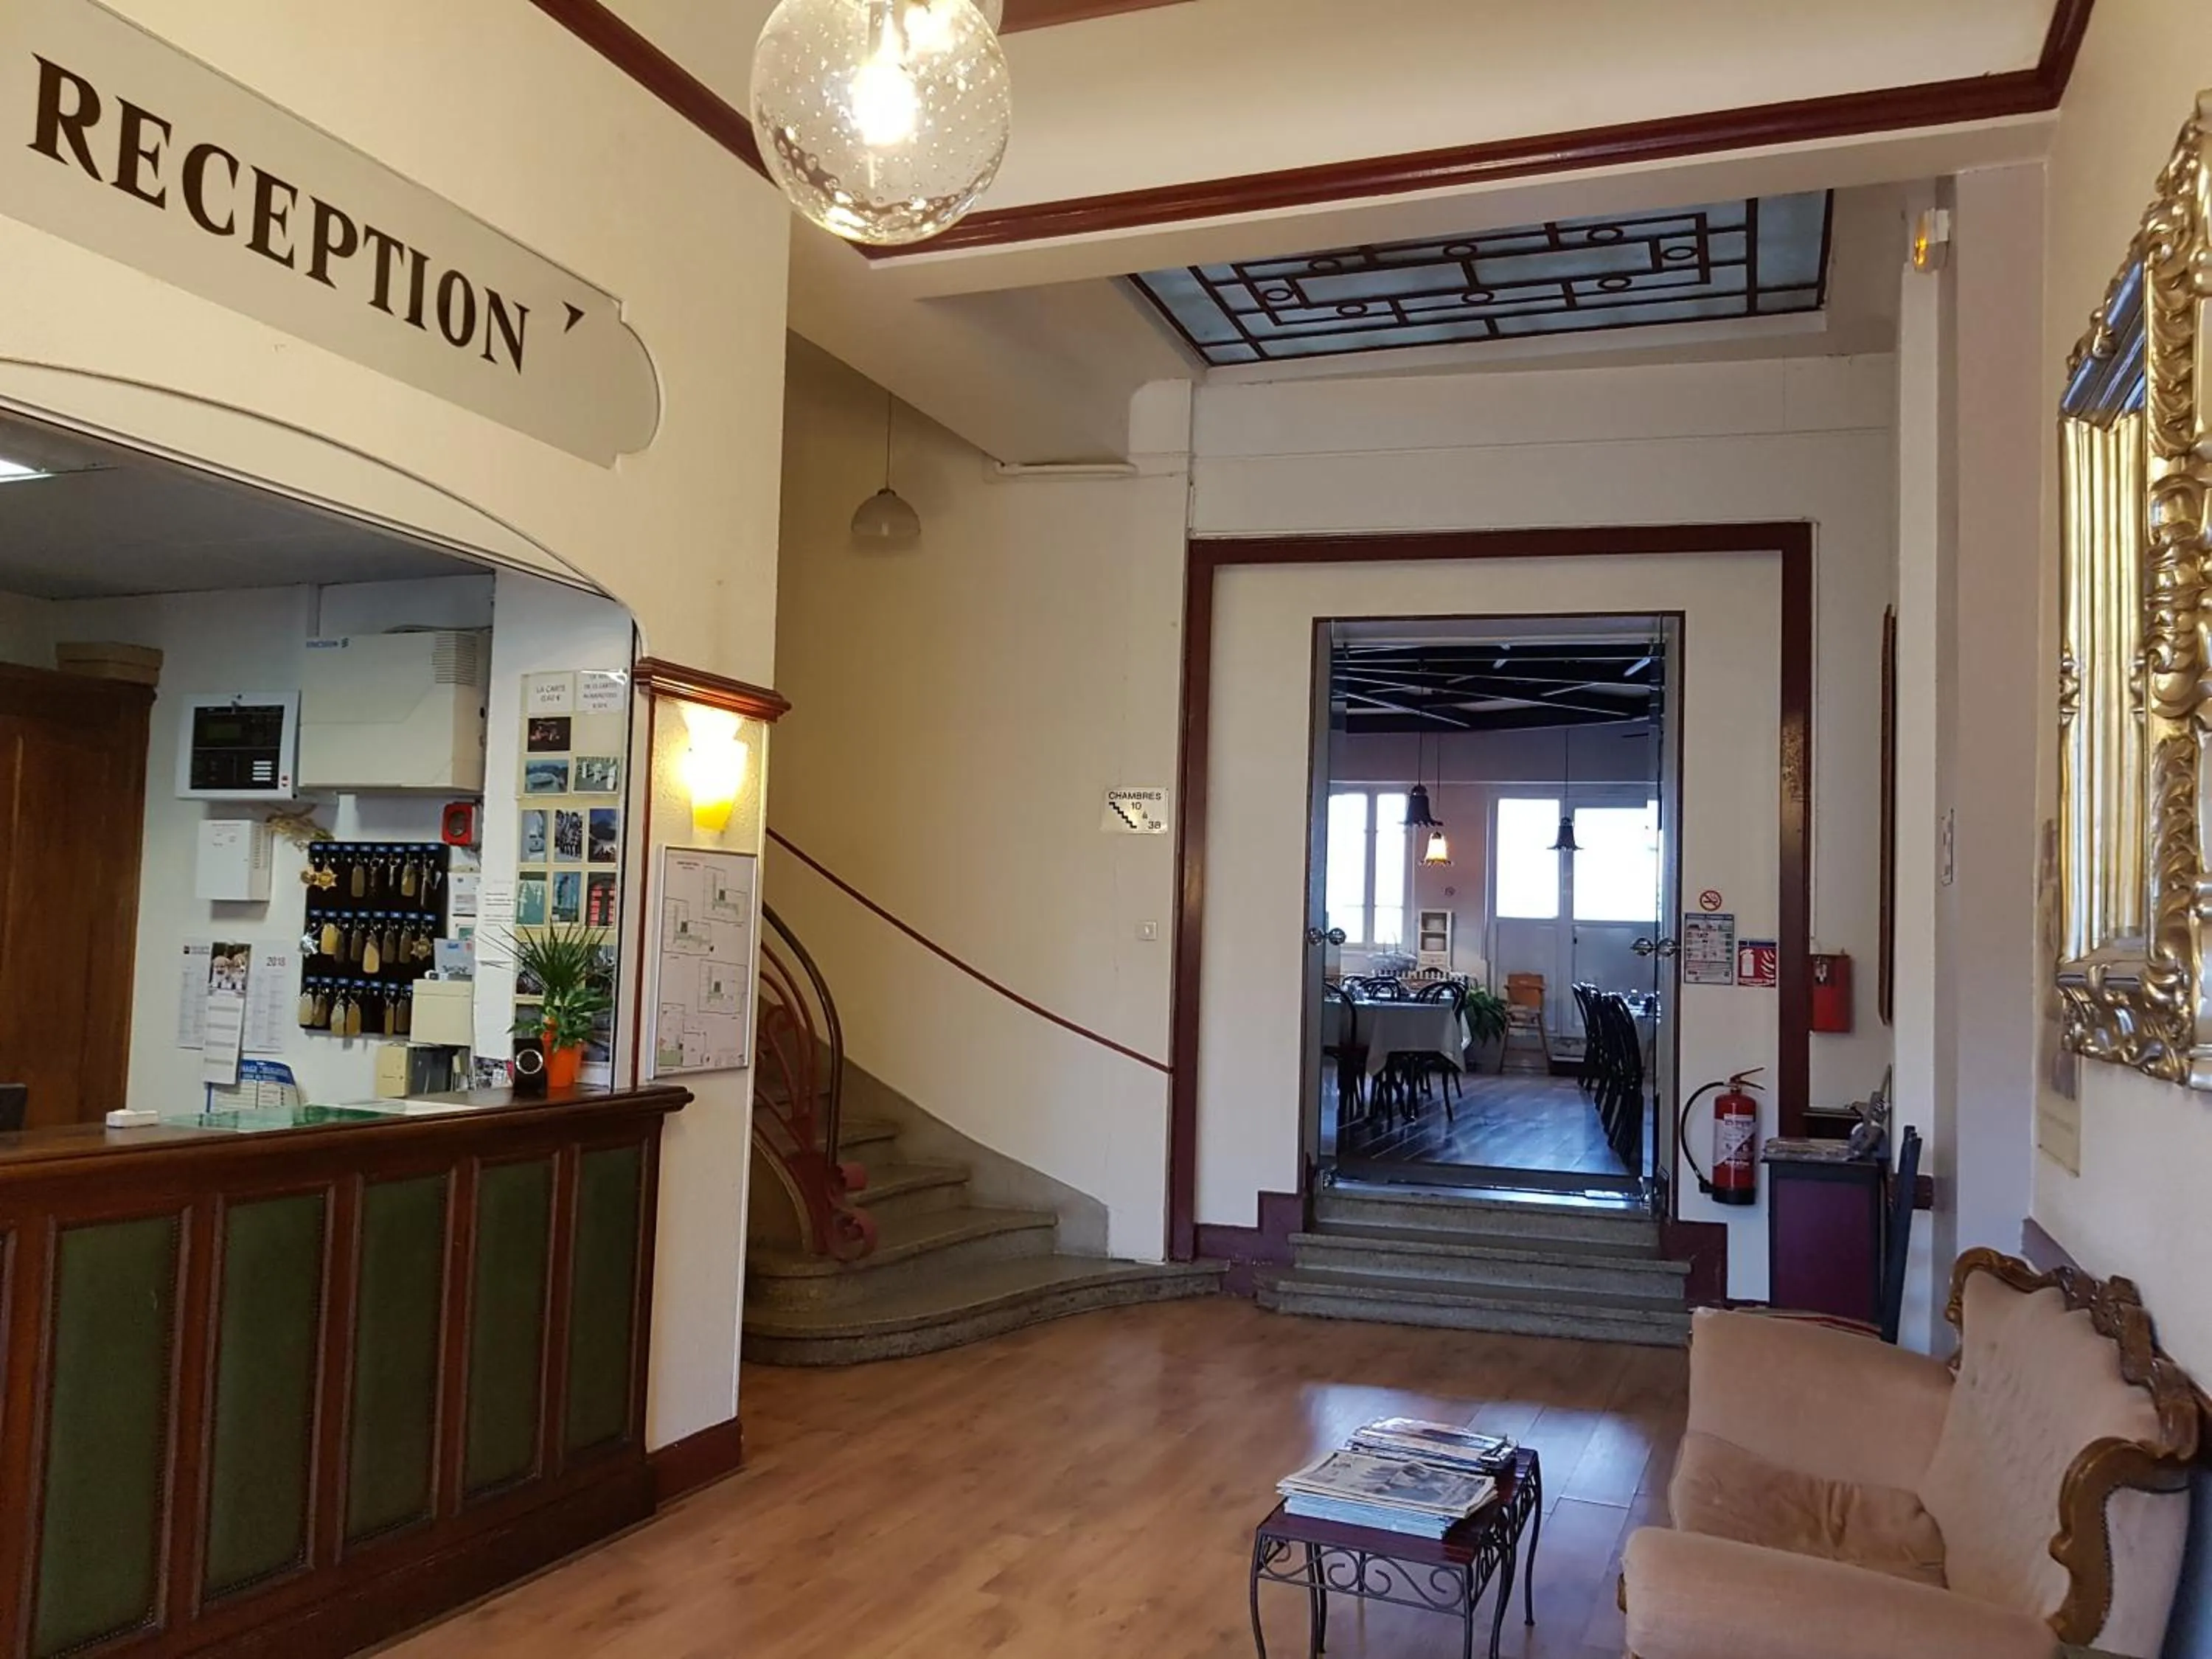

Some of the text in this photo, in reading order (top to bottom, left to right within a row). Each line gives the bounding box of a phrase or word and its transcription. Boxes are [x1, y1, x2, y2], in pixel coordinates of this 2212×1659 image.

[27, 52, 530, 375] RECEPTION
[1108, 791, 1161, 800] CHAMBRES
[1131, 801, 1142, 810] 10
[1148, 821, 1161, 830] 38
